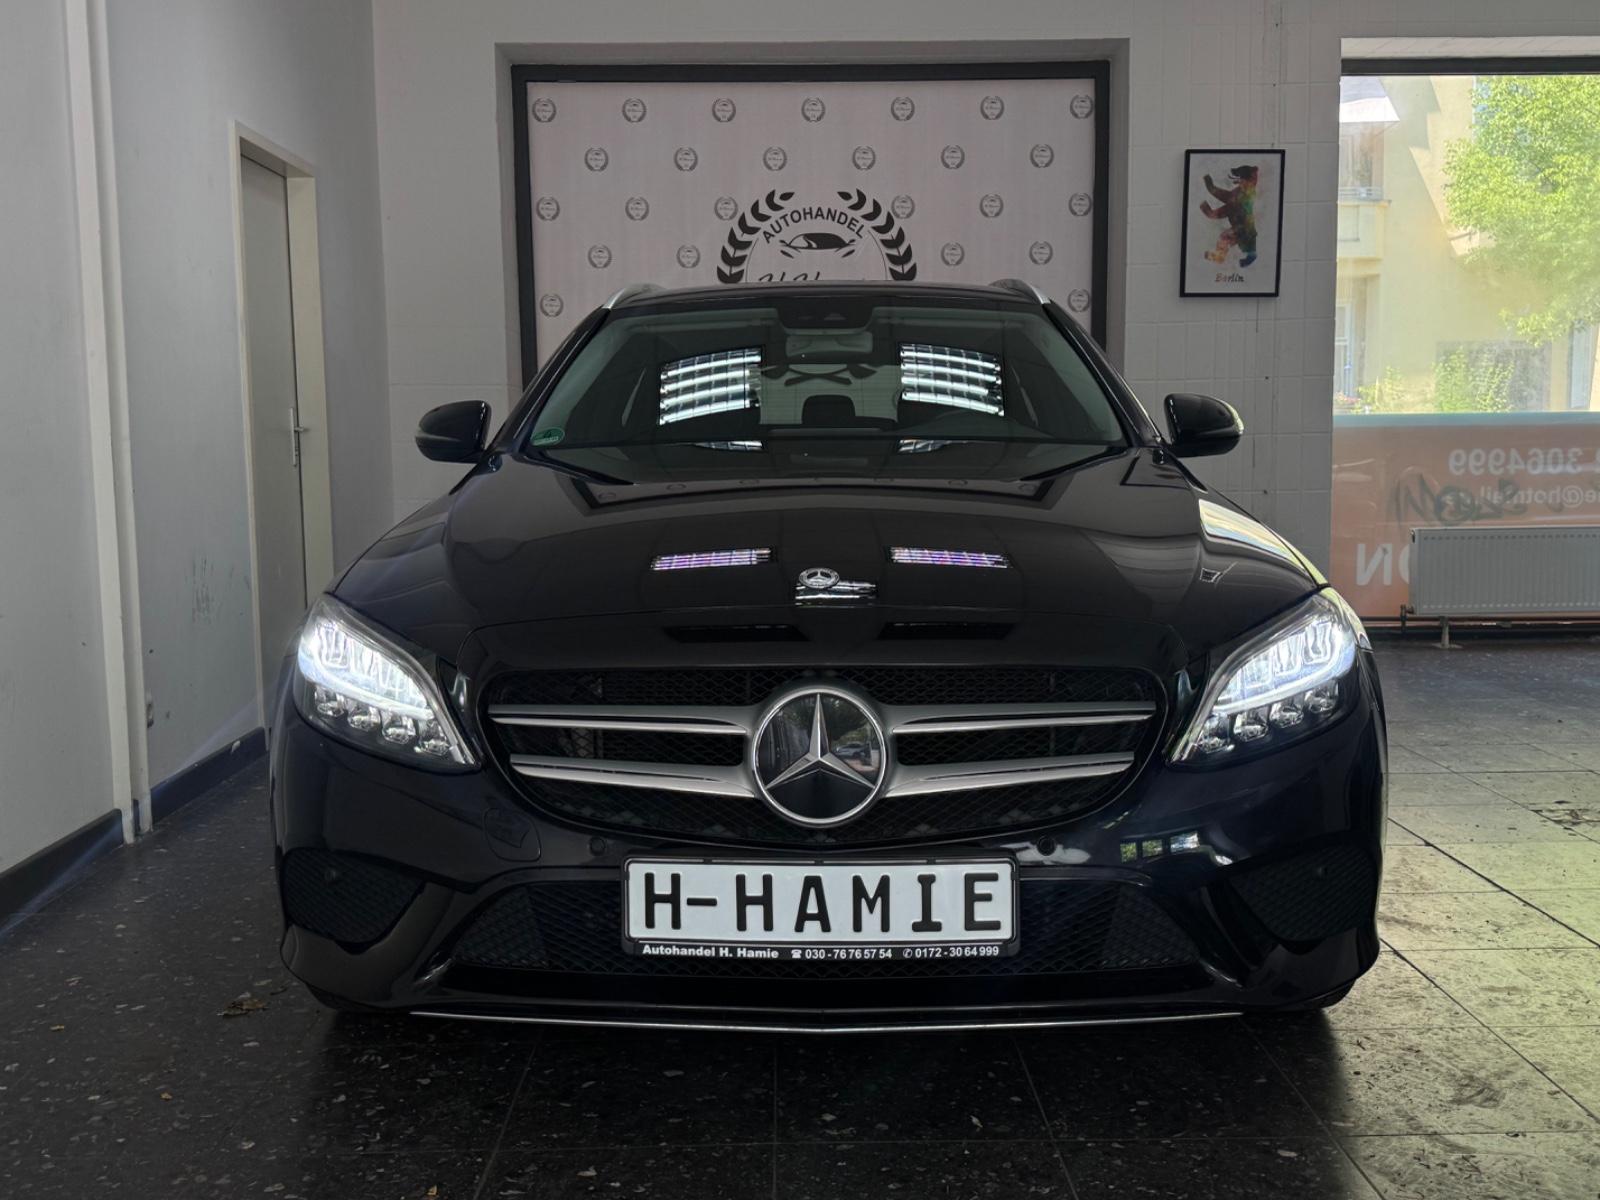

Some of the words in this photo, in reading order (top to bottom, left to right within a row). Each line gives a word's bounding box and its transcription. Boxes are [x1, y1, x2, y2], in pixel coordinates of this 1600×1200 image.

[761, 206, 866, 244] AUTOHANDEL
[1215, 272, 1245, 283] Berlin
[642, 944, 715, 958] Autohandel
[719, 947, 733, 958] H.
[736, 947, 779, 959] Hamie
